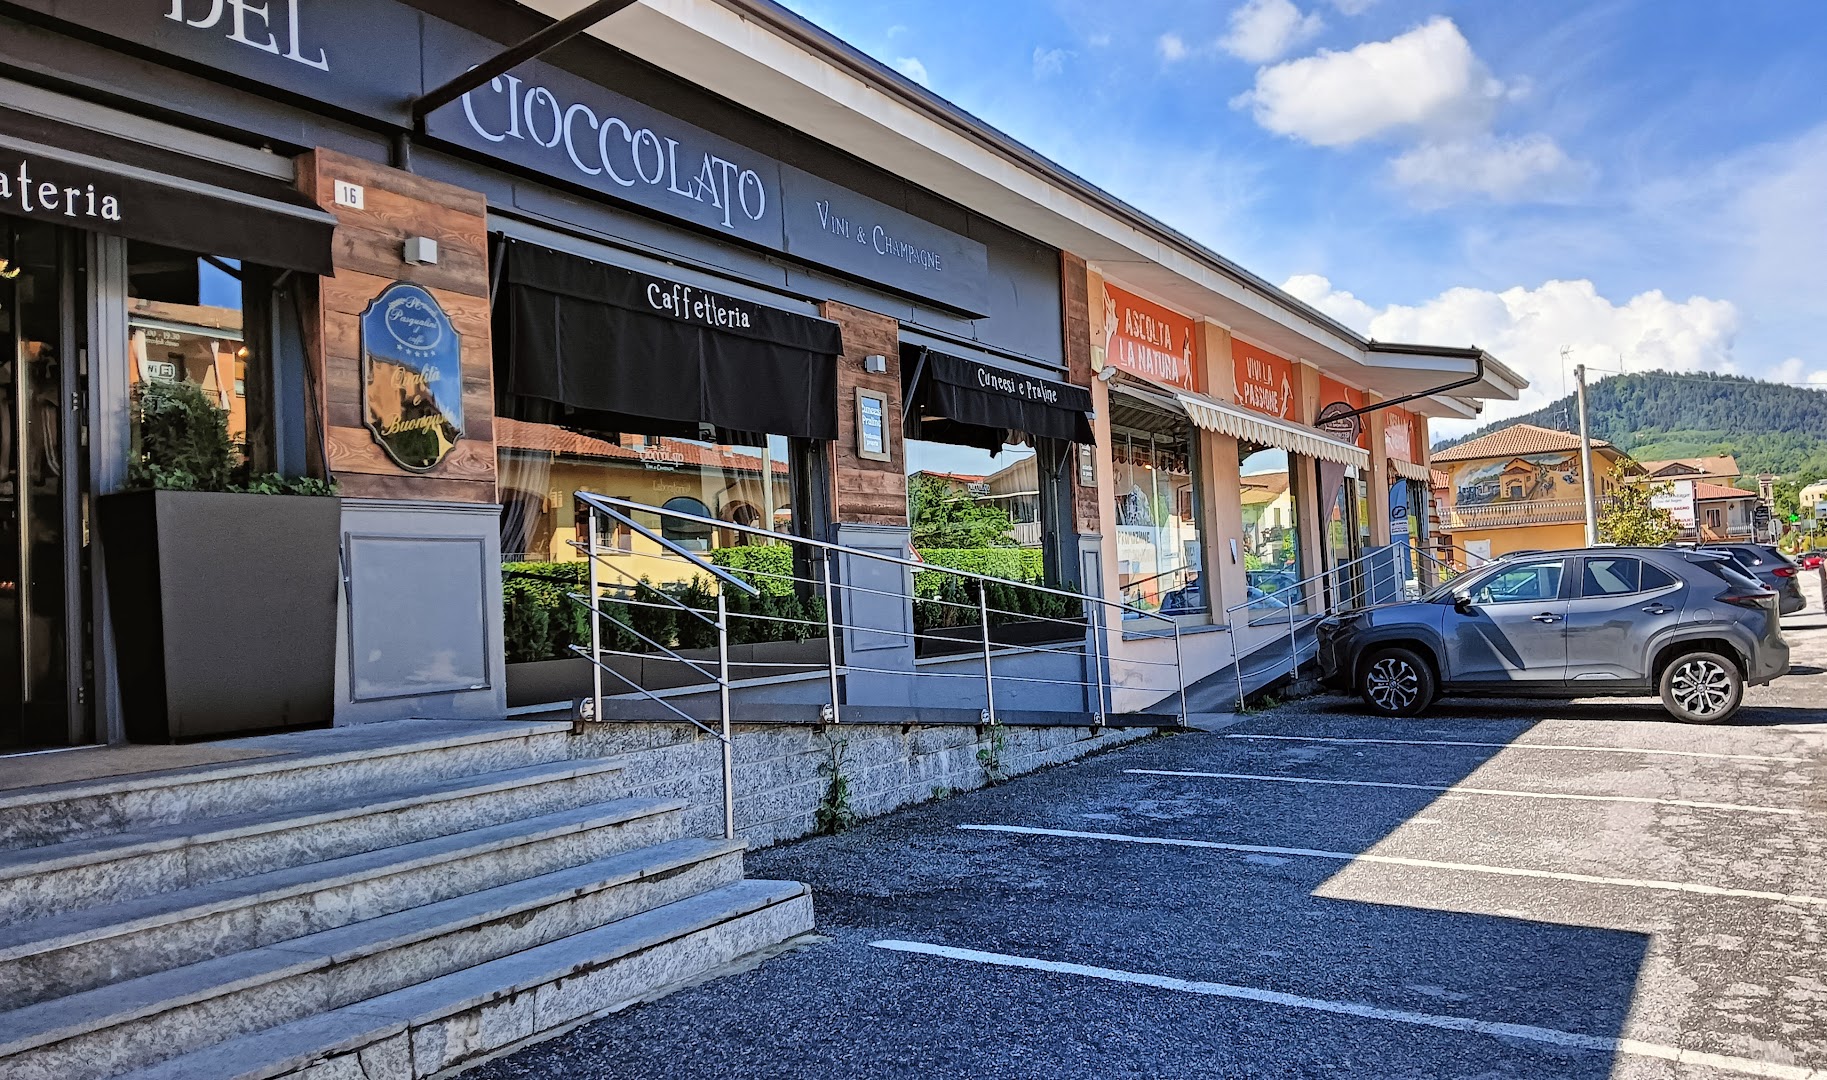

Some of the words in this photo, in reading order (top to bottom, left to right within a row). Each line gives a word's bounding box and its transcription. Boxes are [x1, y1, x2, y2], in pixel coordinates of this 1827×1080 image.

[461, 64, 767, 229] CIOCCOLATO
[342, 185, 358, 204] 16
[856, 226, 868, 246] &
[646, 282, 751, 330] Caffetteria
[1124, 307, 1173, 351] ASCOLTA
[1119, 337, 1136, 370] LA
[1136, 344, 1179, 384] NATURA
[1246, 356, 1262, 380] VIVI
[1262, 364, 1273, 386] LA
[978, 367, 1015, 395] Cuneesi
[1018, 383, 1025, 395] e
[1026, 379, 1058, 404] Praline
[1244, 381, 1279, 414] PASSIONE
